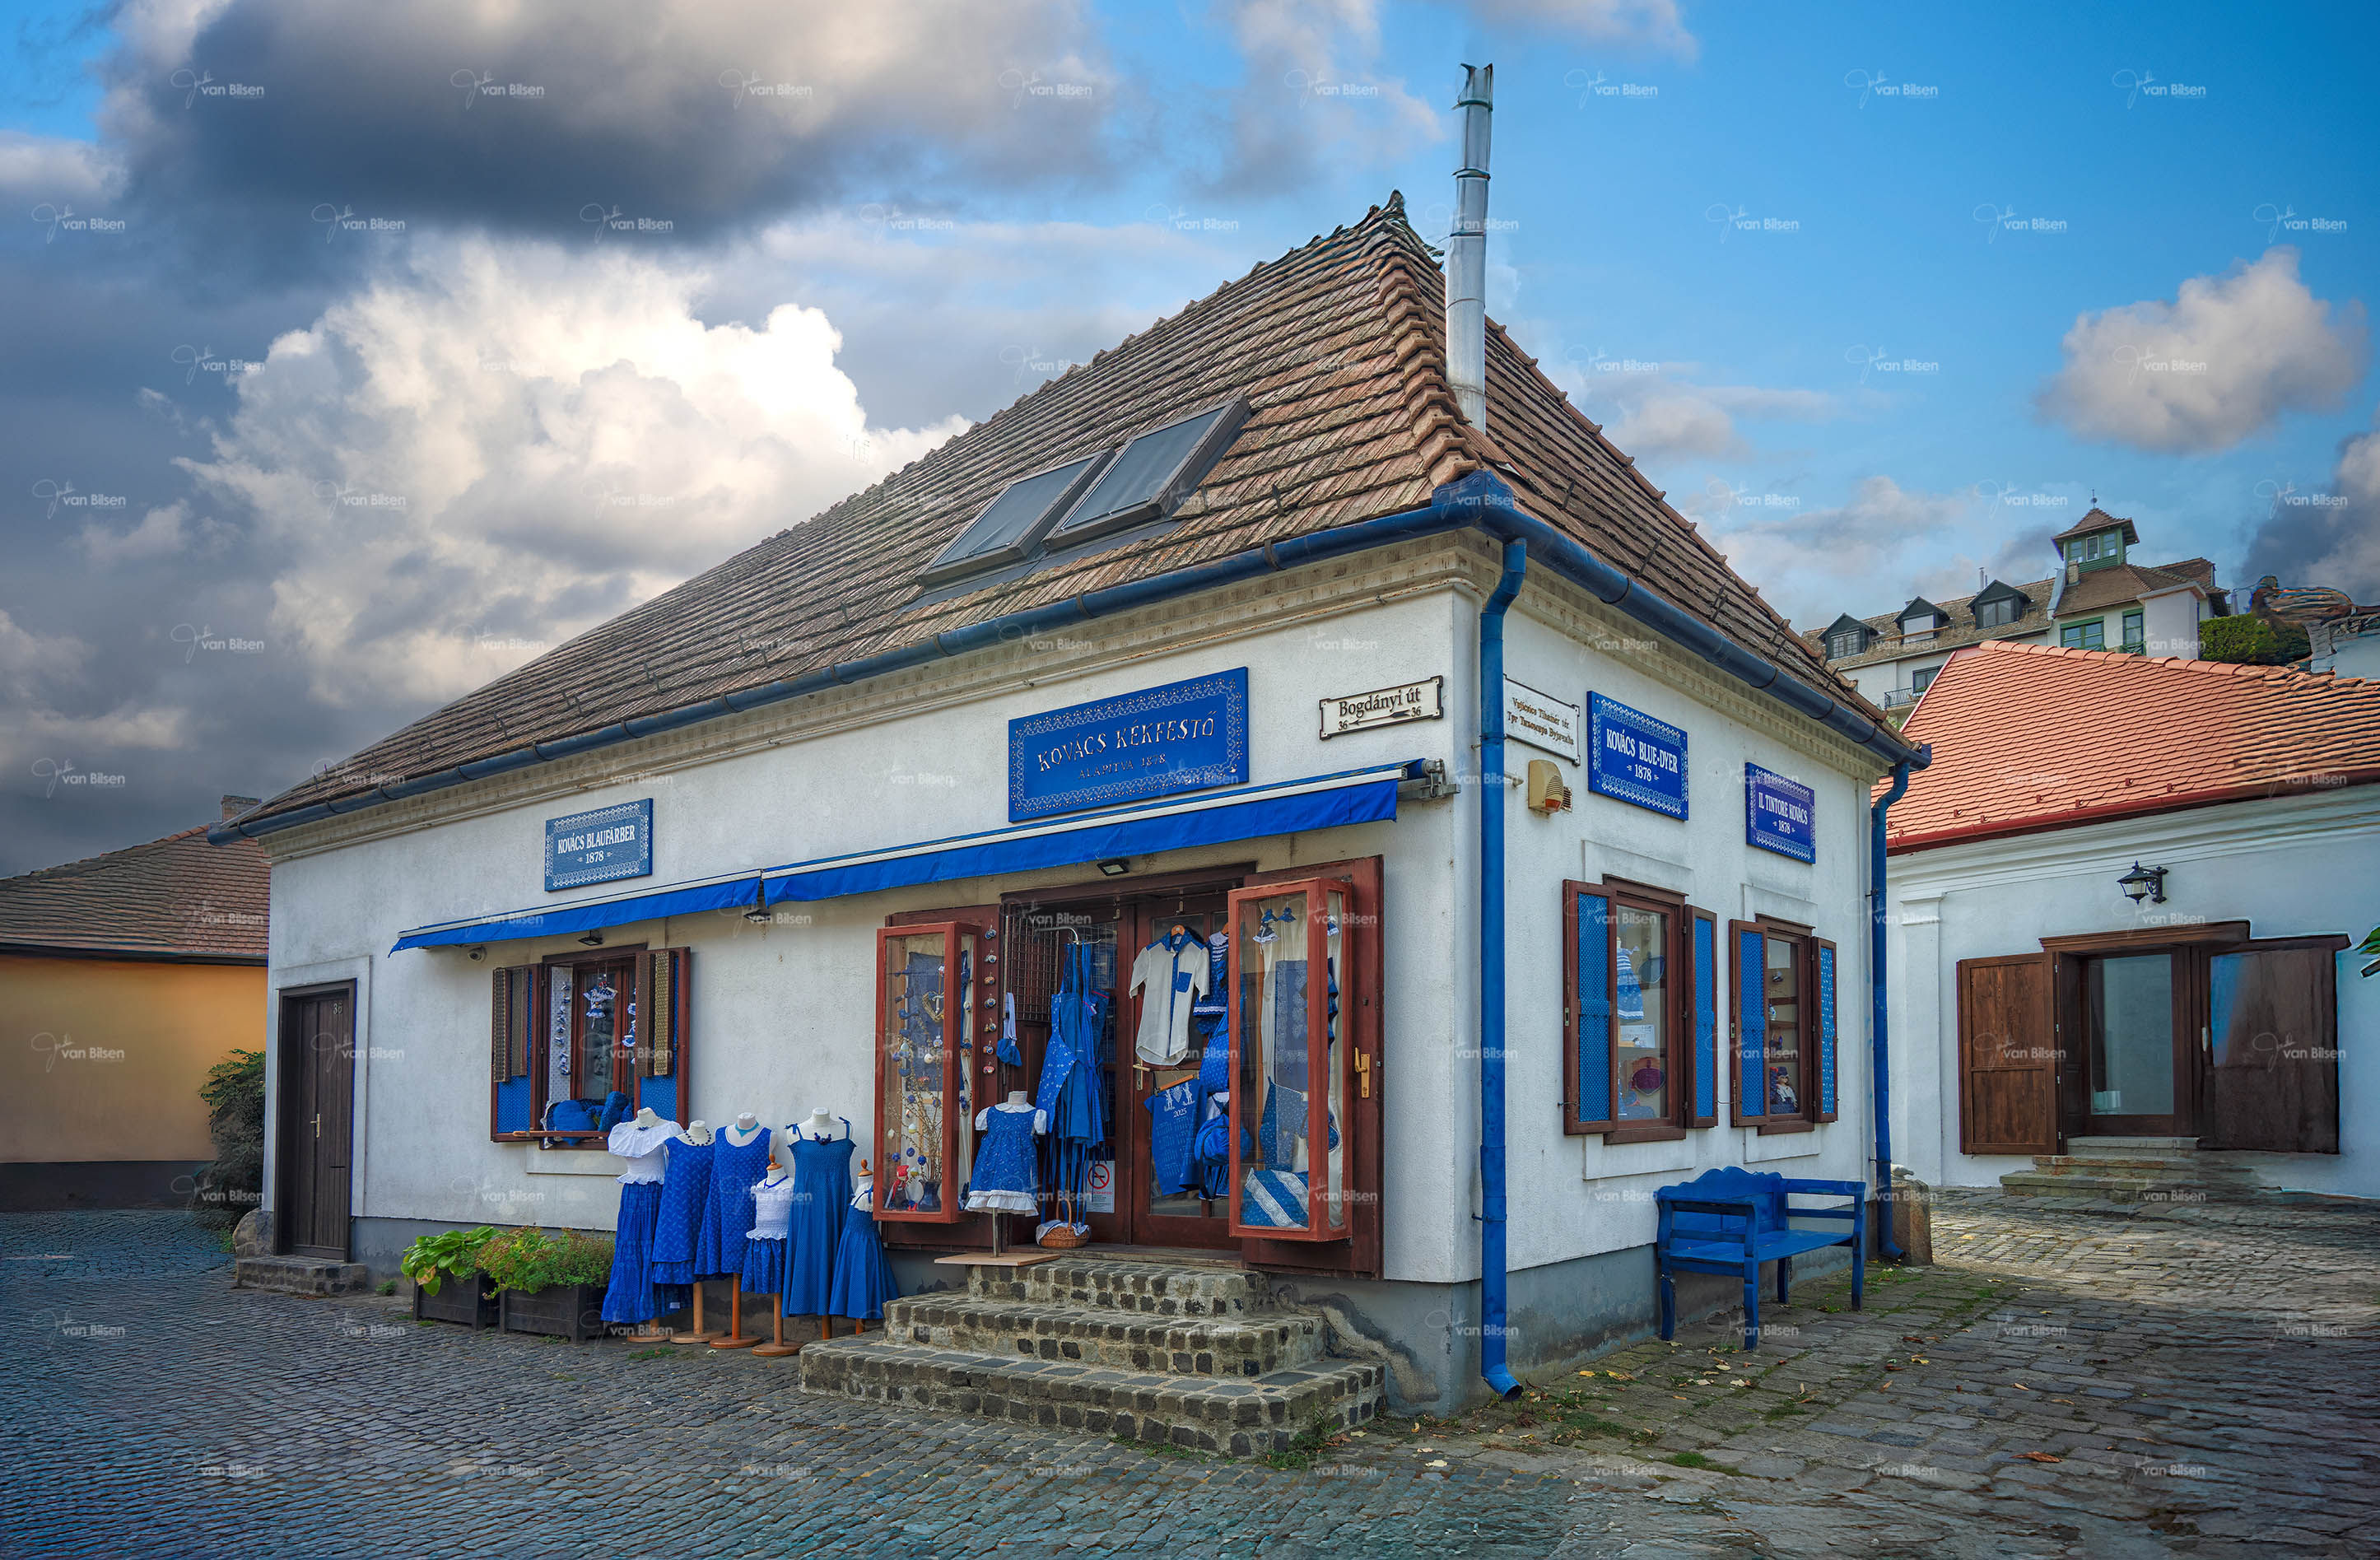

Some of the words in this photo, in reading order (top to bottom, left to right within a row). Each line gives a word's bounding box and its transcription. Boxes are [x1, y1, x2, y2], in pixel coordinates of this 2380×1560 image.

[1339, 689, 1403, 719] Bogdányi
[1406, 687, 1422, 703] út
[1338, 719, 1348, 731] 36
[1411, 706, 1422, 718] 36
[1037, 733, 1106, 772] KOVÁCS
[1115, 711, 1217, 749] KÉKFESTŐ
[1606, 729, 1636, 757] KOVÁCS
[1141, 753, 1166, 766] 1878
[1634, 764, 1652, 782] 1878
[1758, 792, 1765, 809] IL
[1765, 794, 1788, 817] TINTORE
[1789, 803, 1808, 825] KOVÁCS
[1778, 819, 1791, 834] 1878
[557, 831, 585, 854] KOVÁCS
[586, 824, 636, 849] BLAUFÄRBER
[585, 850, 604, 864] 1878
[333, 1002, 342, 1014] 36
[1173, 1107, 1187, 1118] 2025
